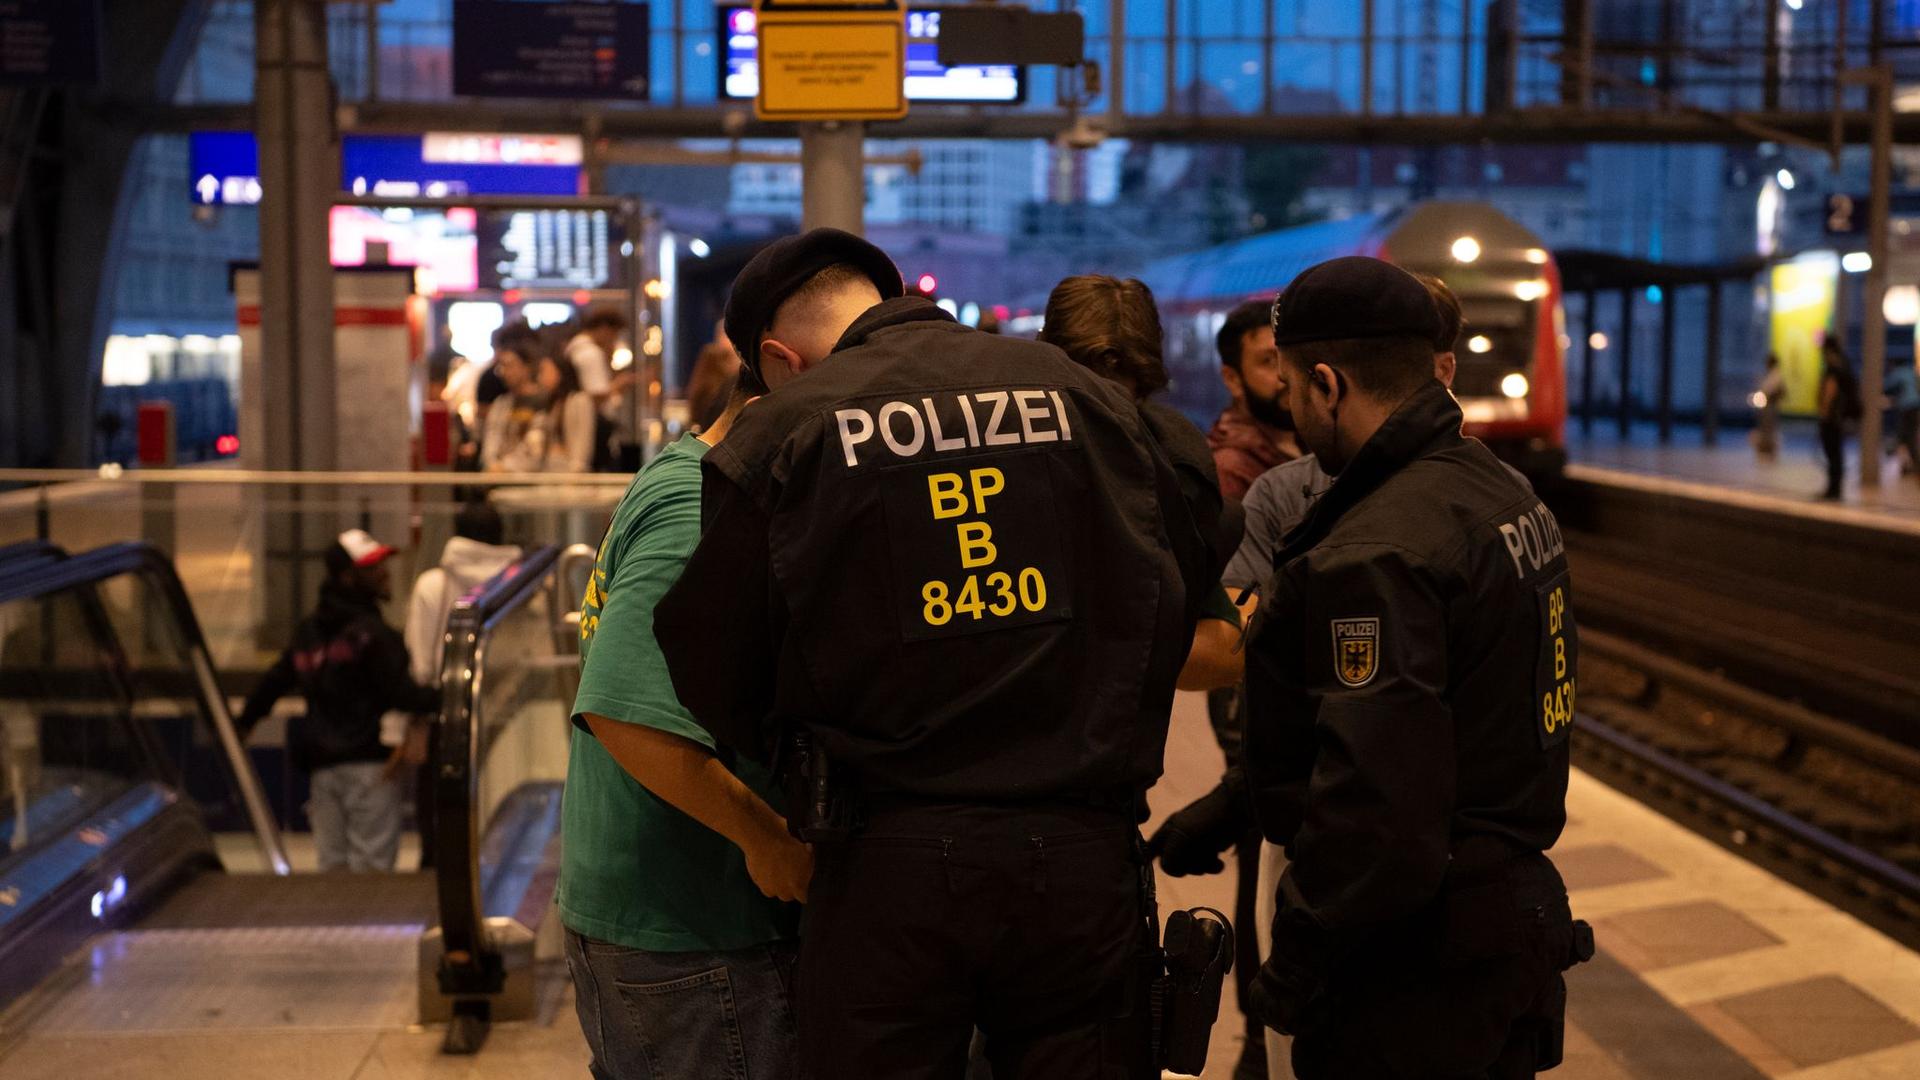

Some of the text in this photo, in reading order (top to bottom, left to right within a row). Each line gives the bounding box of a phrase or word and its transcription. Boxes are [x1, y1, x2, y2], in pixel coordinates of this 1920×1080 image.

[1828, 193, 1853, 231] 2
[835, 390, 1072, 467] POLIZEI
[928, 467, 1005, 519] BP
[957, 521, 998, 569] B
[922, 566, 1047, 626] 8430
[1549, 587, 1564, 635] BP
[1336, 623, 1376, 637] POLIZEI
[1555, 636, 1566, 680] B
